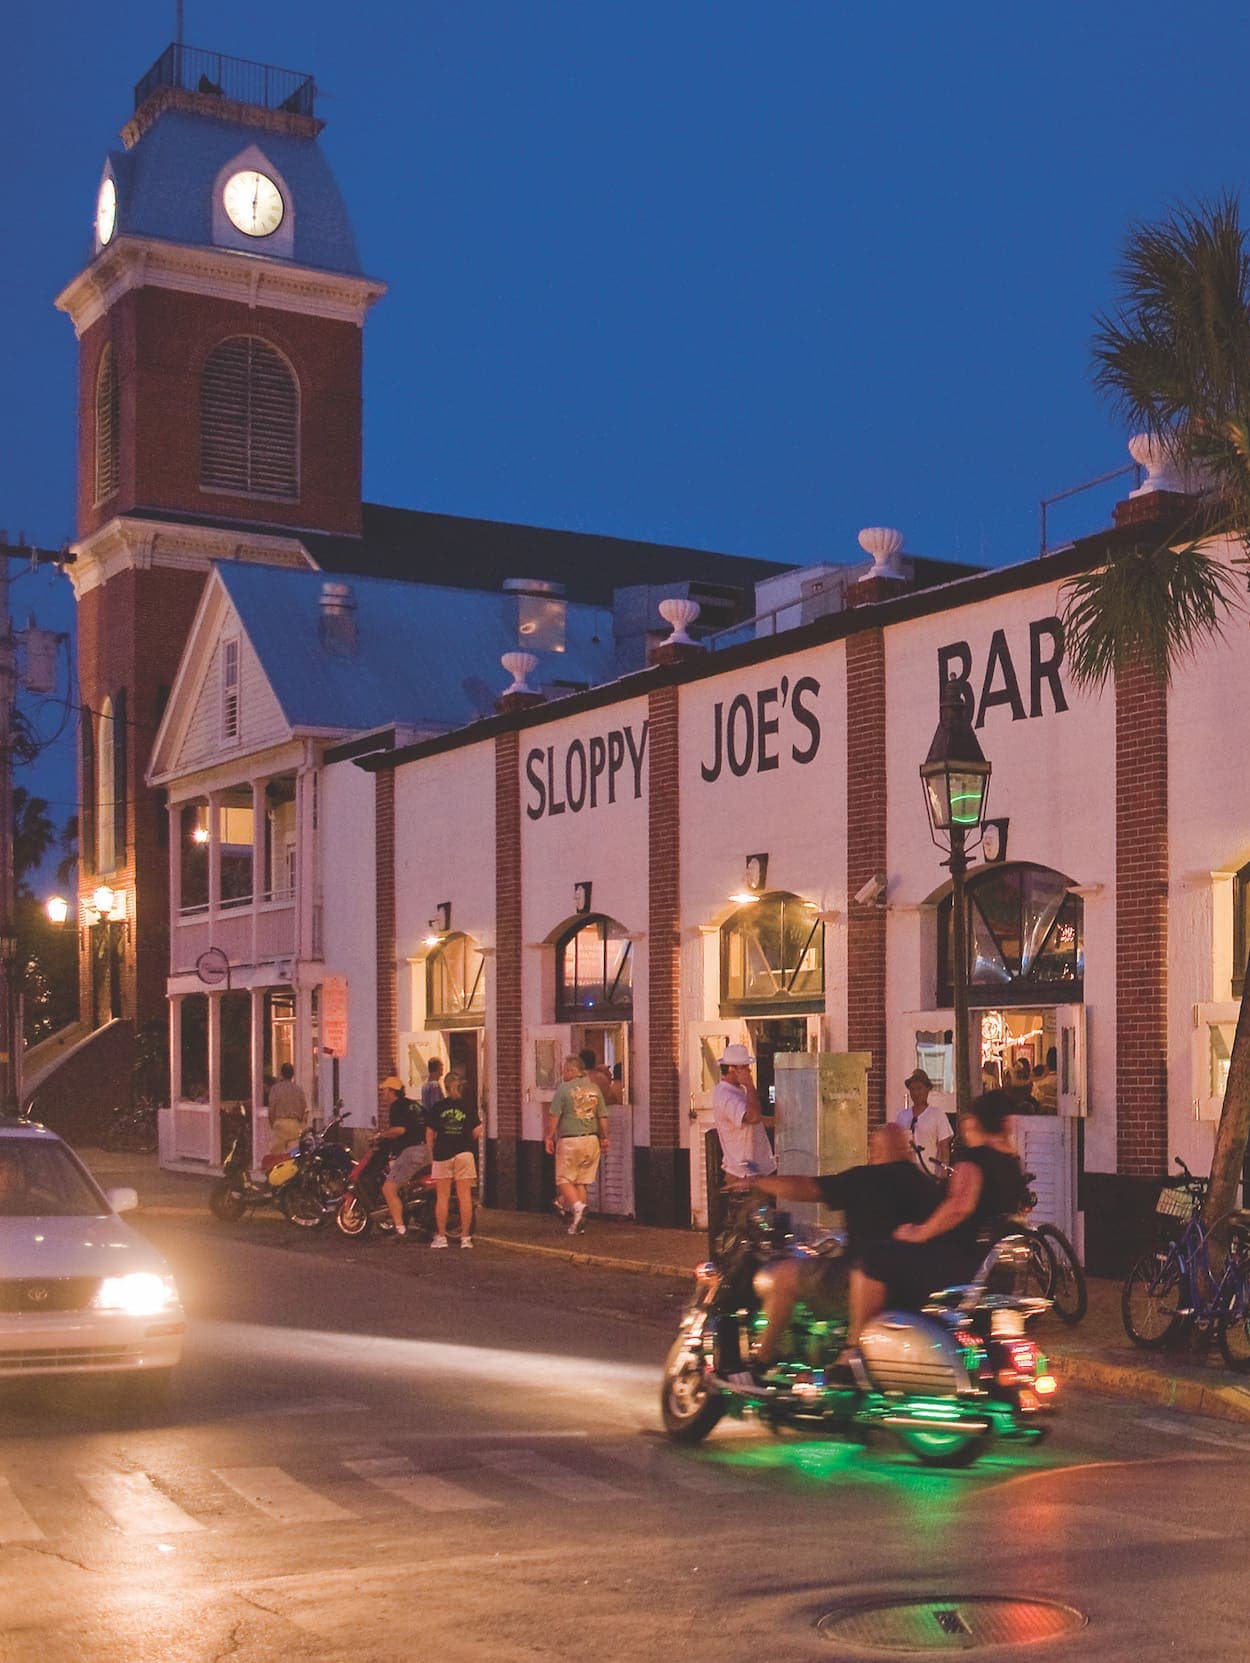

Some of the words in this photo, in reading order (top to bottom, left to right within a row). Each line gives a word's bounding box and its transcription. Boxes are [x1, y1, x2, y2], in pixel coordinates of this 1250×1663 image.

[526, 720, 649, 820] SLOPPY
[701, 675, 822, 784] JOE'S
[937, 616, 1070, 730] BAR
